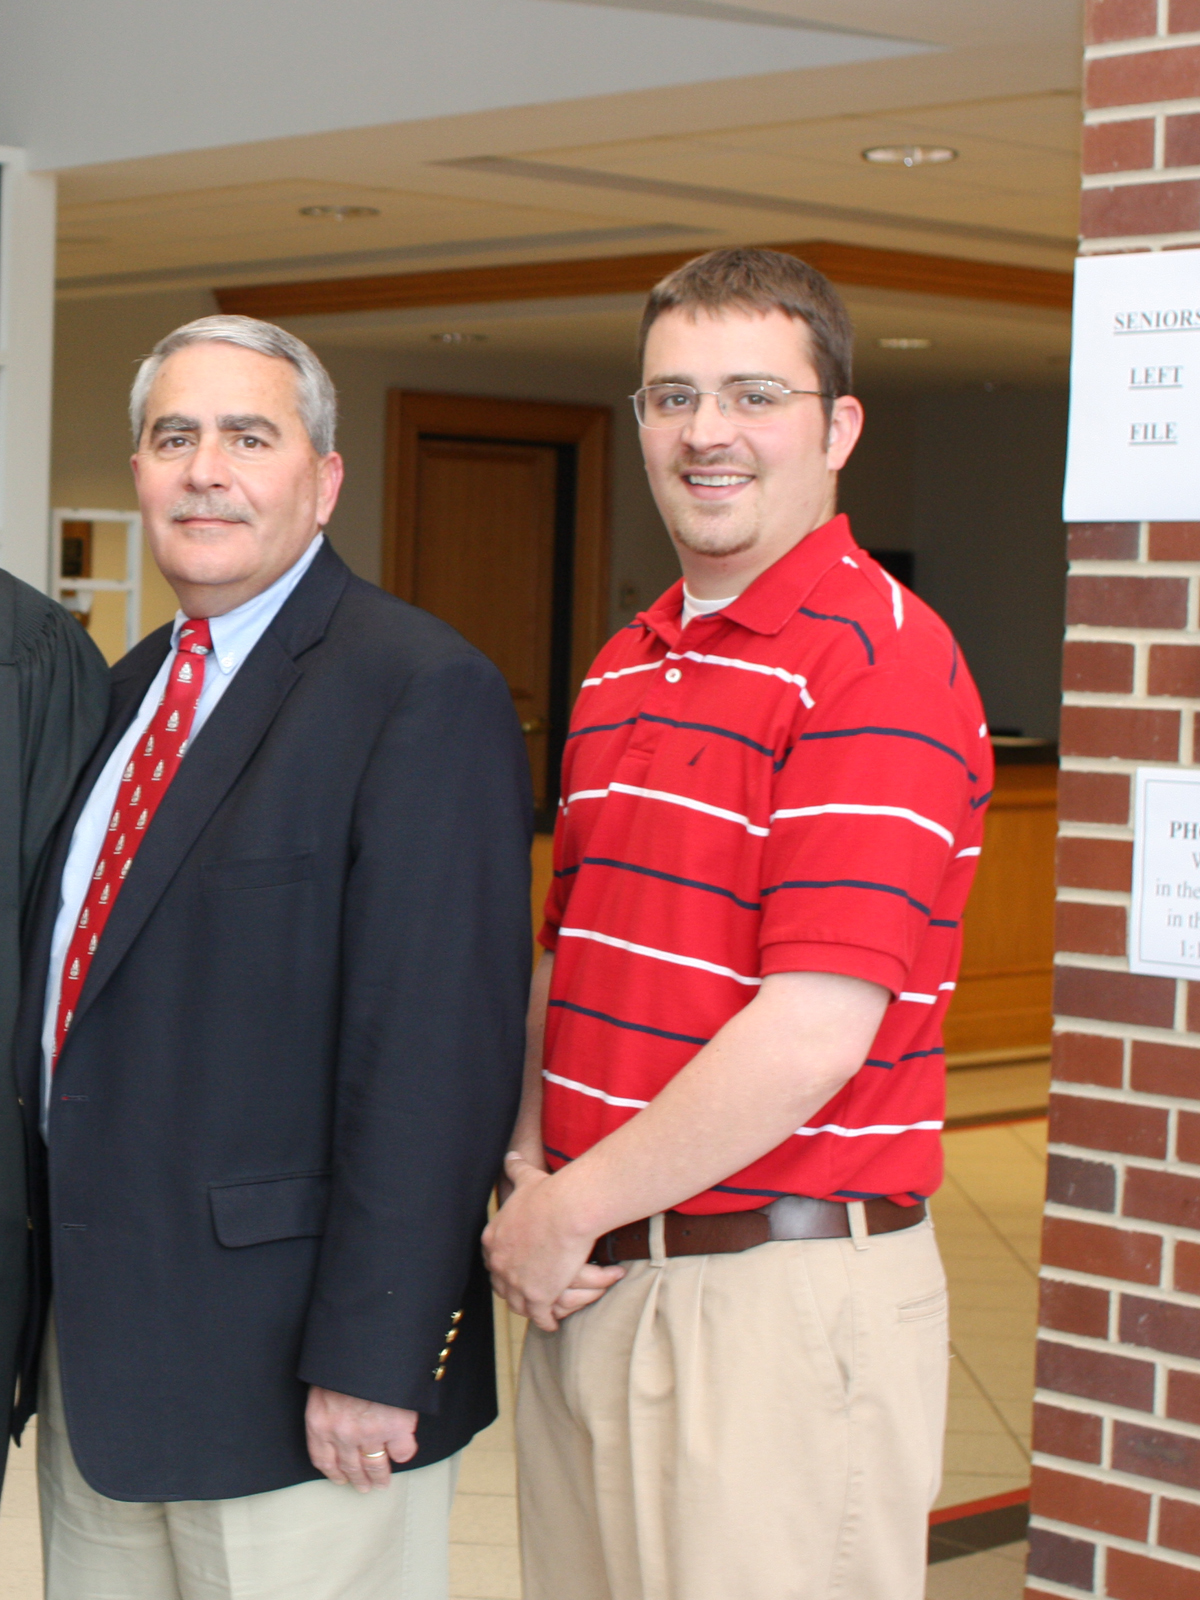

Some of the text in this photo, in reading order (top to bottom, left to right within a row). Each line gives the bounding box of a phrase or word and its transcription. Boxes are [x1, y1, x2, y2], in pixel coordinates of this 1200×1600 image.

[1130, 365, 1184, 386] LEFT
[1130, 421, 1178, 442] FILE
[1169, 820, 1200, 839] PH
[1155, 877, 1200, 899] in the
[1166, 908, 1182, 927] in
